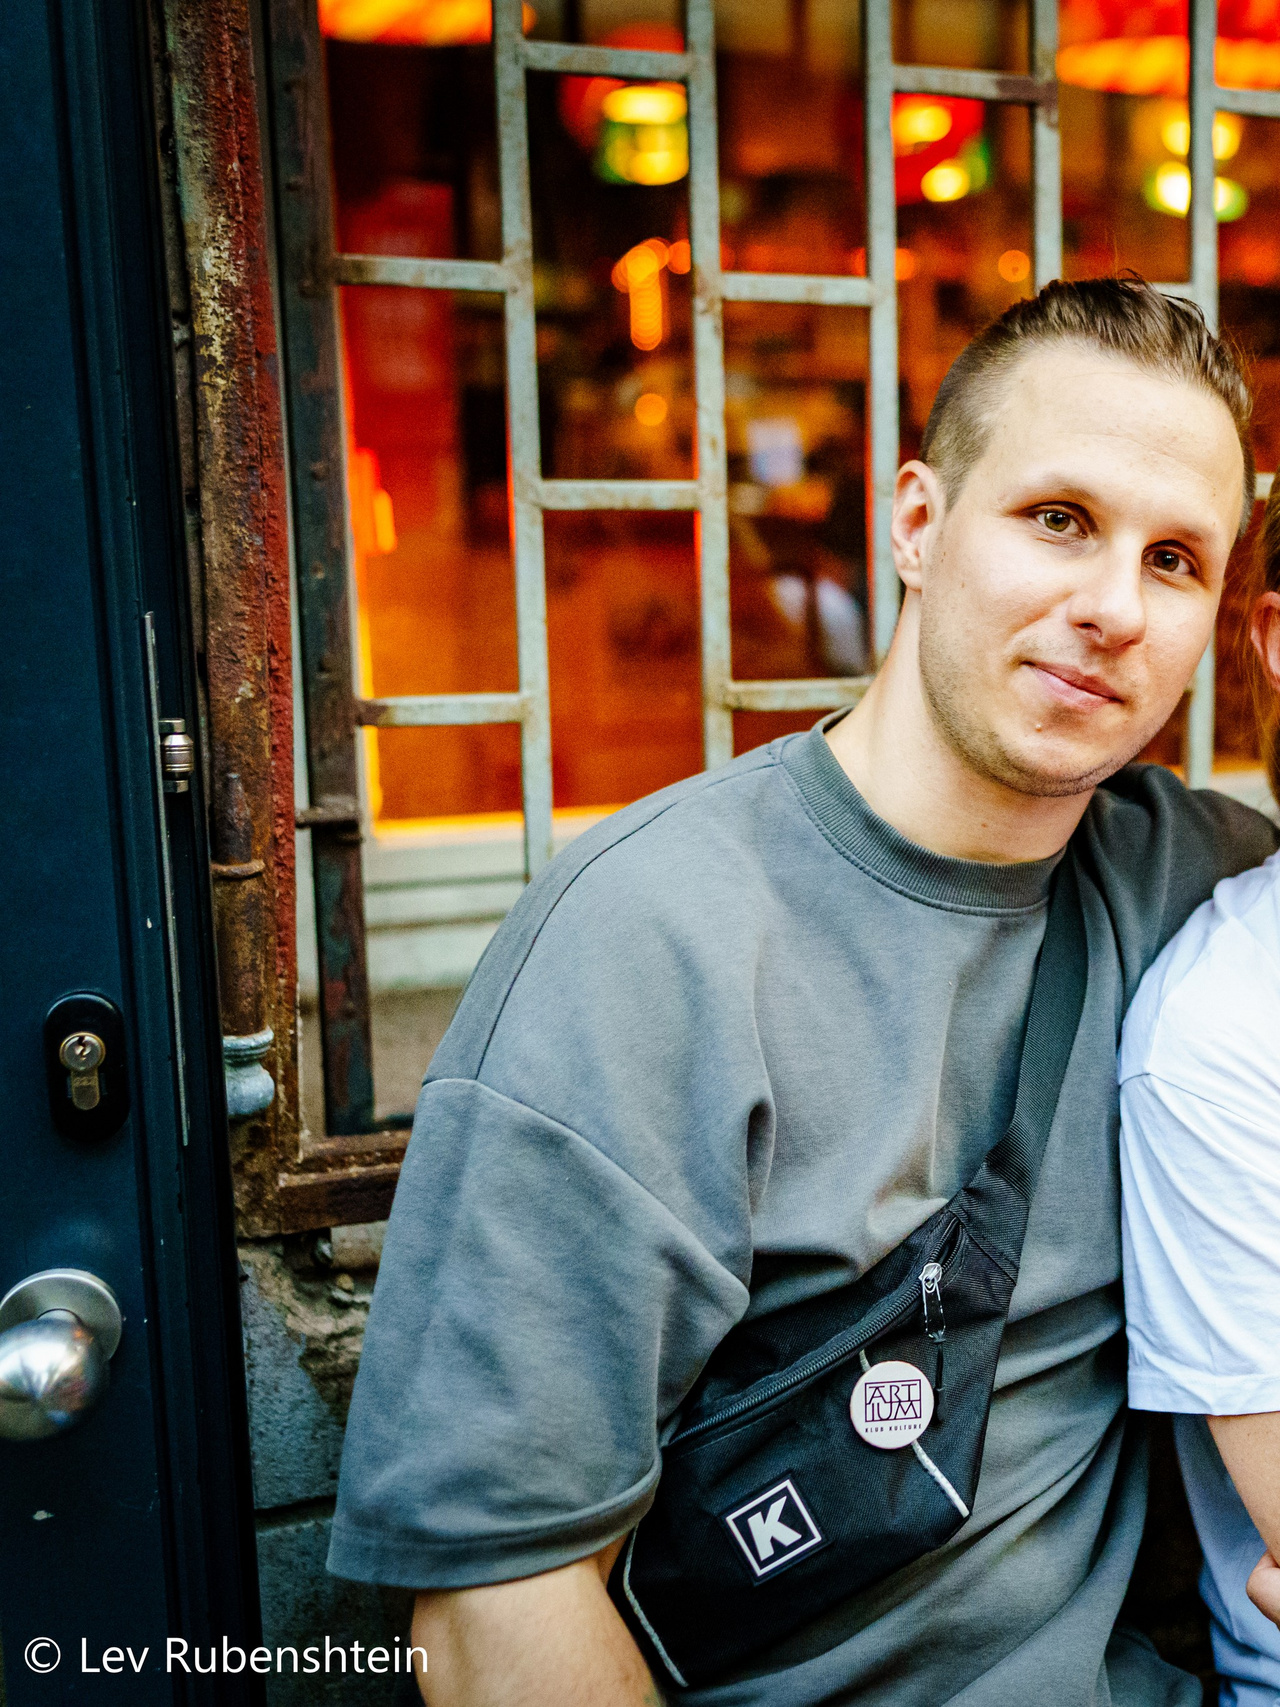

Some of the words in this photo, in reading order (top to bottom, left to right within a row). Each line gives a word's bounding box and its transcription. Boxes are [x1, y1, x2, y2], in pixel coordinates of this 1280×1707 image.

[866, 1383, 918, 1404] ART
[889, 1423, 922, 1432] KULTURE
[747, 1495, 802, 1561] K
